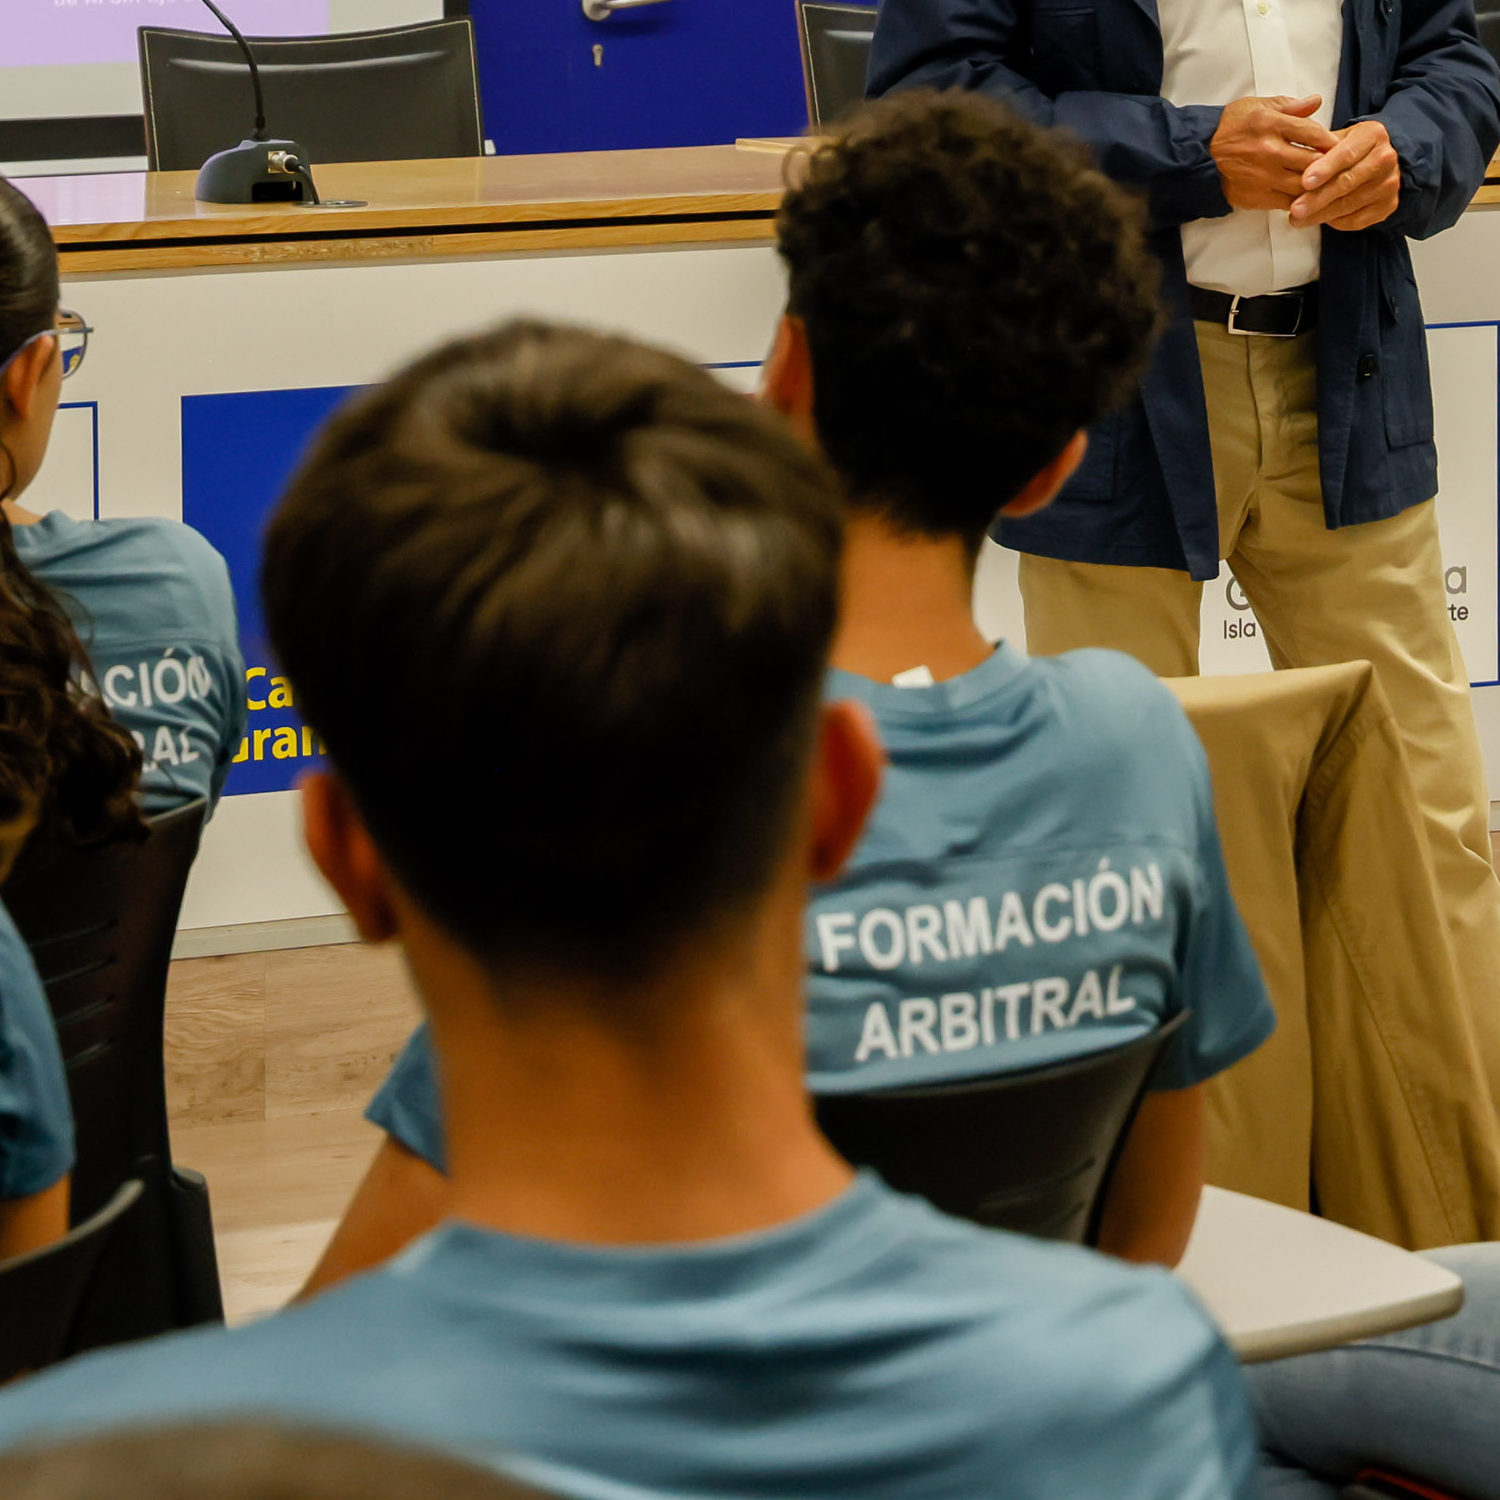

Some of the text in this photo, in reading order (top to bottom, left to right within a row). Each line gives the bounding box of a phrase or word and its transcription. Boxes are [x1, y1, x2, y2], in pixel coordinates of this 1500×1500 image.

[1223, 618, 1256, 639] Isla
[816, 858, 1165, 972] FORMACIÓN
[854, 965, 1137, 1062] ARBITRAL
